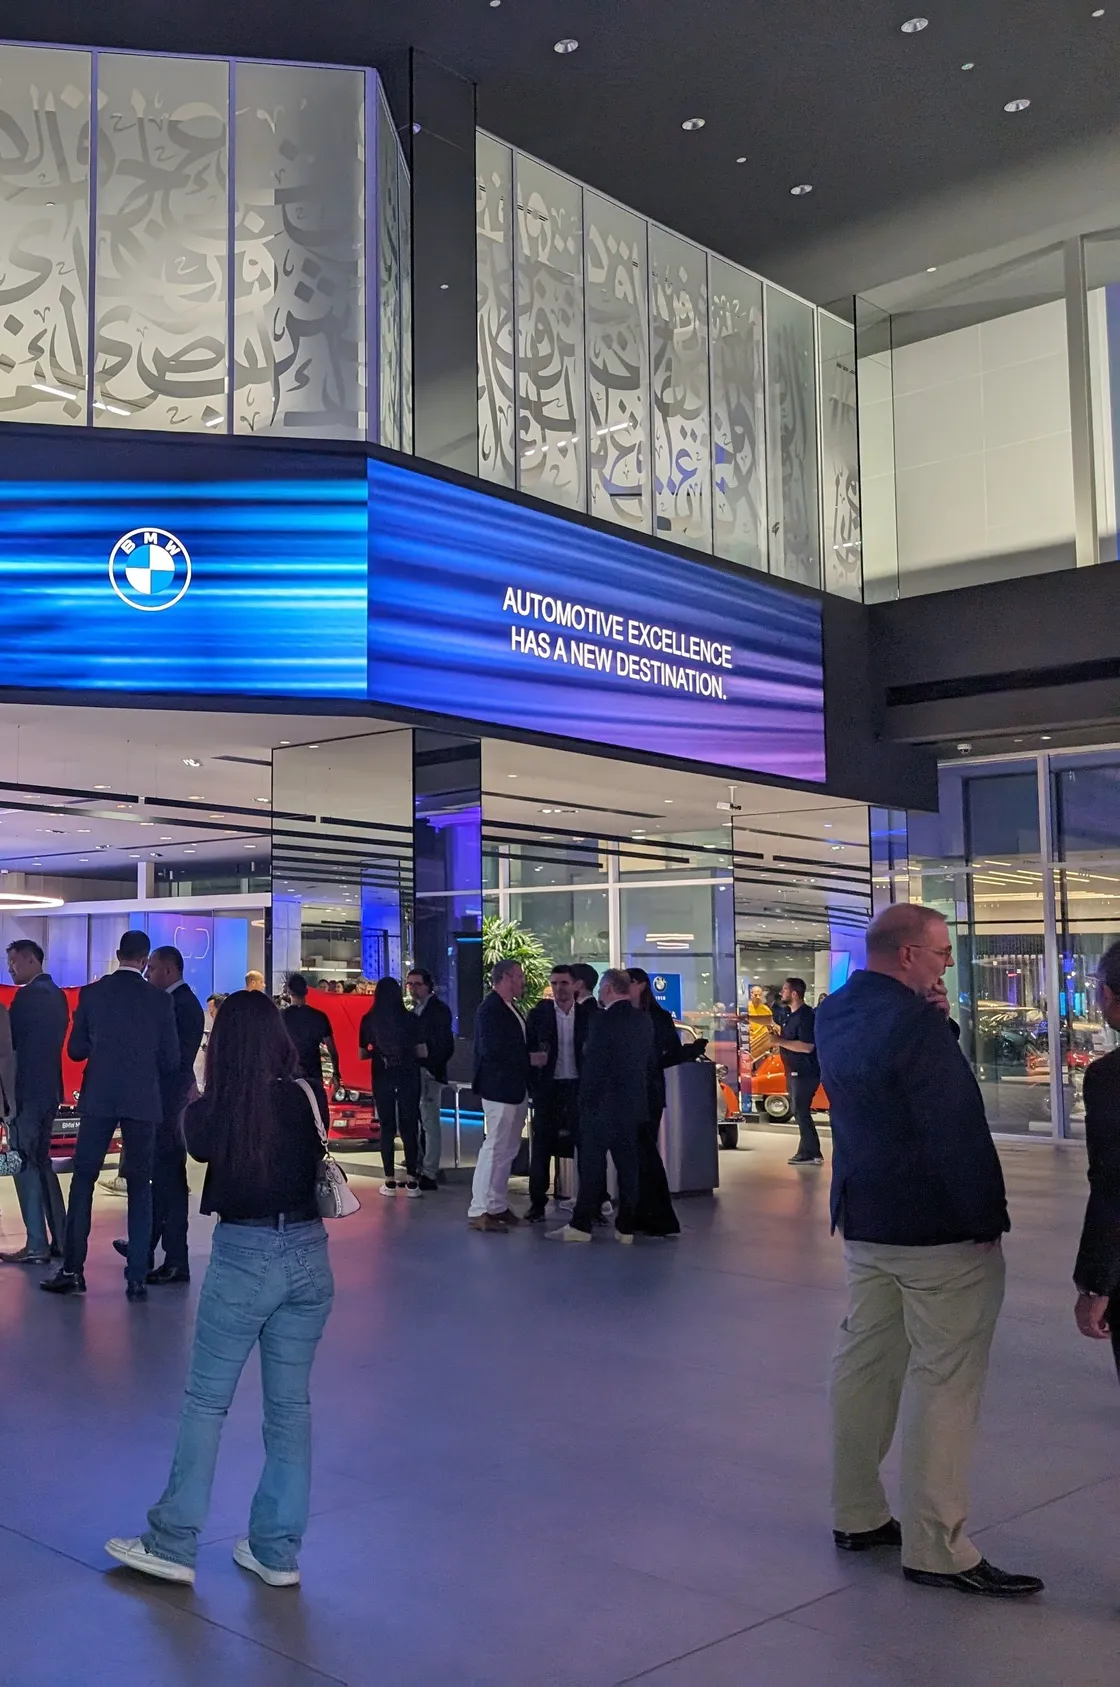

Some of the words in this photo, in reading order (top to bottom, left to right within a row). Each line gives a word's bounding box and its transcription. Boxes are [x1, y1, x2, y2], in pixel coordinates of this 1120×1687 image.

[120, 532, 181, 556] BMW
[502, 586, 624, 641] AUTOMOTIVE
[628, 620, 733, 669] EXCELLENCE
[511, 626, 551, 659] HAS
[553, 637, 568, 663] A
[571, 640, 613, 673] NEW
[616, 652, 727, 700] DESTINATION.
